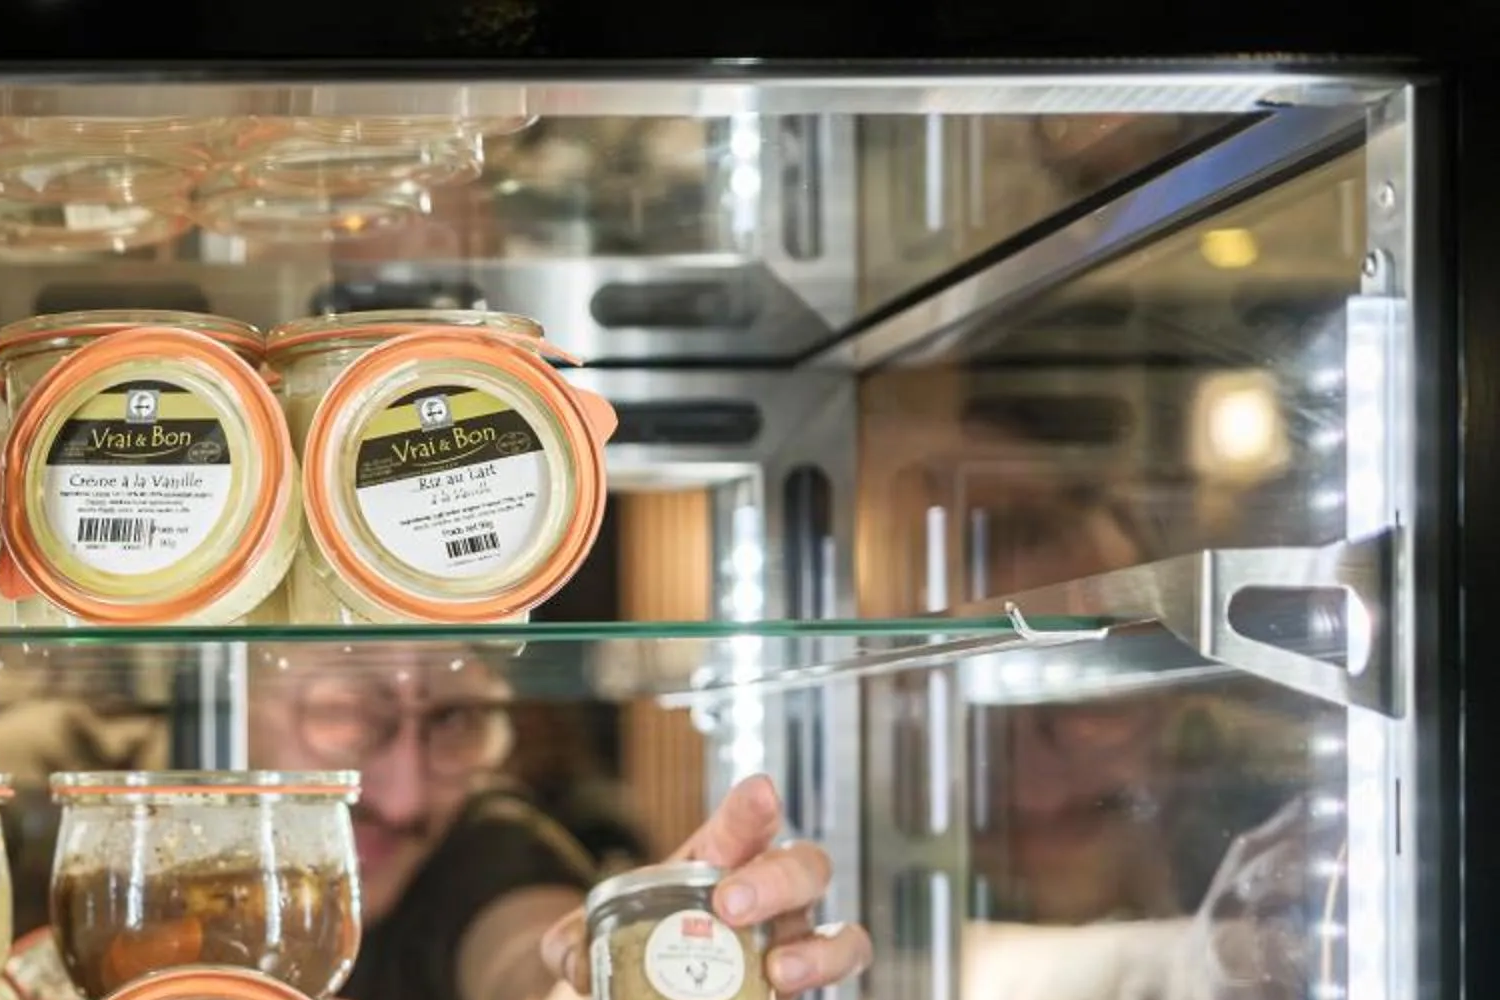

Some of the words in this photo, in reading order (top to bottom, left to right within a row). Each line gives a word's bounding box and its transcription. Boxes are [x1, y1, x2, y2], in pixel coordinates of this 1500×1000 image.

[91, 427, 132, 450] Vrai
[135, 435, 148, 447] &
[152, 425, 192, 447] Bon
[391, 438, 436, 463] Vrai
[439, 439, 451, 451] &
[452, 426, 497, 449] Bon
[121, 474, 129, 488] à
[133, 473, 147, 488] la
[447, 474, 464, 486] au
